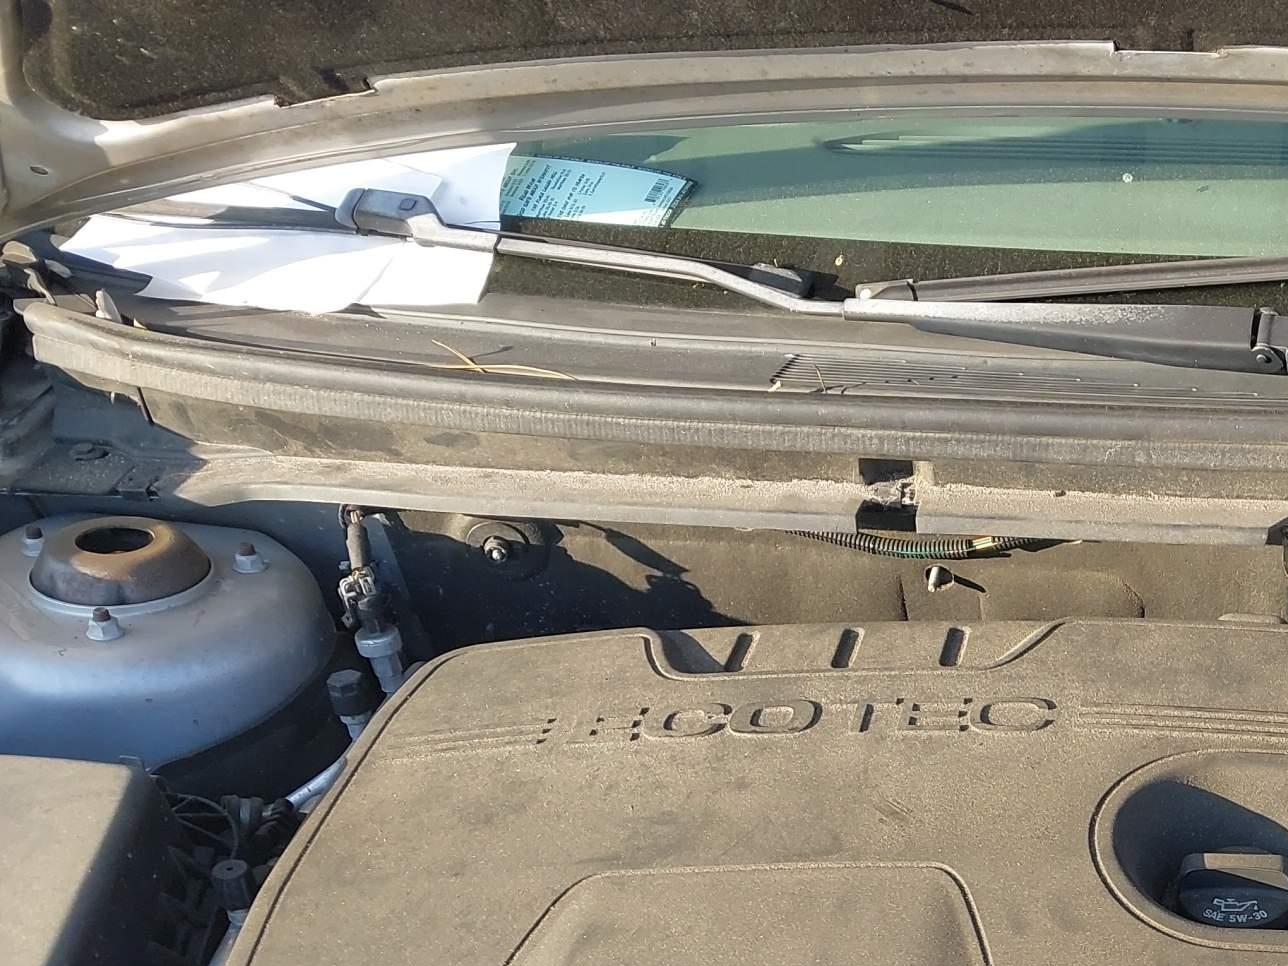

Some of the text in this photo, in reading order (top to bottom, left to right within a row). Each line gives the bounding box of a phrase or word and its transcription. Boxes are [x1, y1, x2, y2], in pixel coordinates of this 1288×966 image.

[567, 697, 1058, 746] ECOTEC
[1202, 909, 1268, 923] SAE 5W-30
